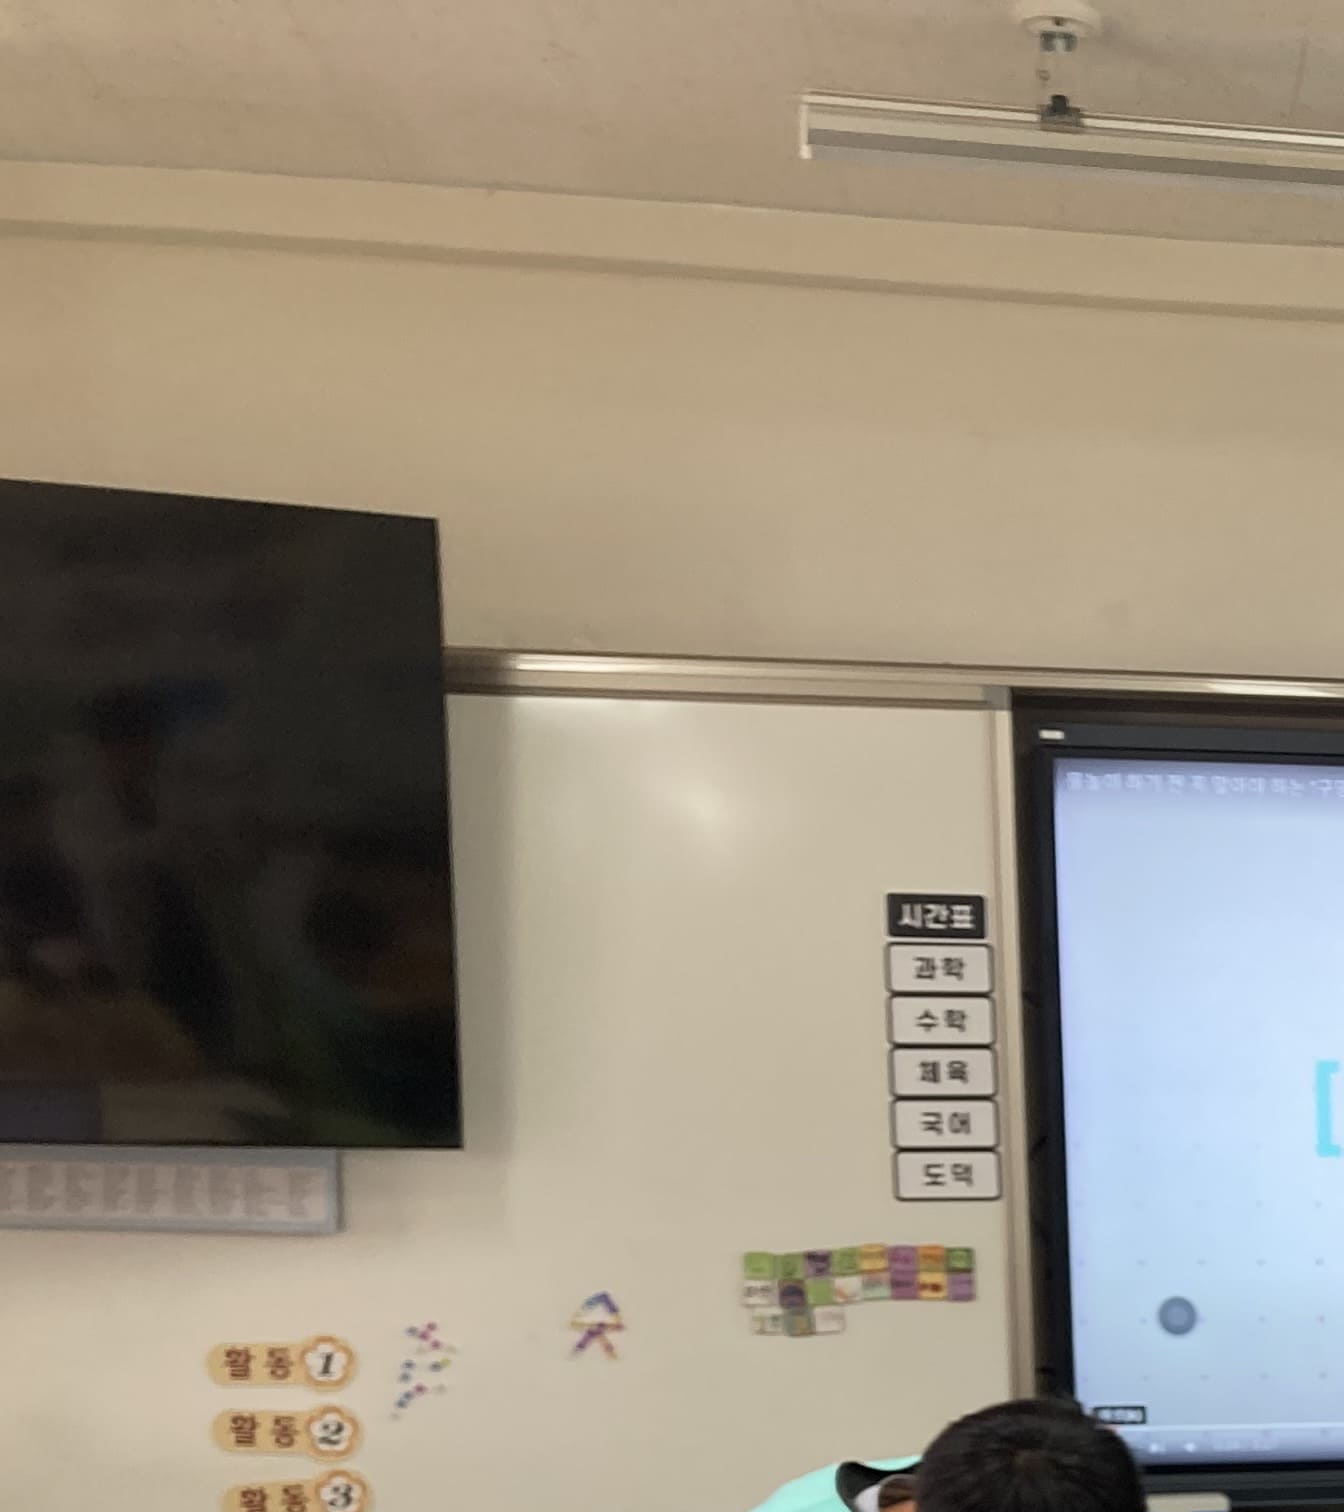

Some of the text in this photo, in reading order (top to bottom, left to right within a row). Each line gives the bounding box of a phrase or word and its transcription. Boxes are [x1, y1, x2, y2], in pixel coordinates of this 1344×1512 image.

[898, 902, 976, 930] 시간표
[915, 1009, 968, 1034] 수학
[317, 1351, 336, 1379] 1
[317, 1418, 344, 1447] 2
[327, 1482, 354, 1510] 3
